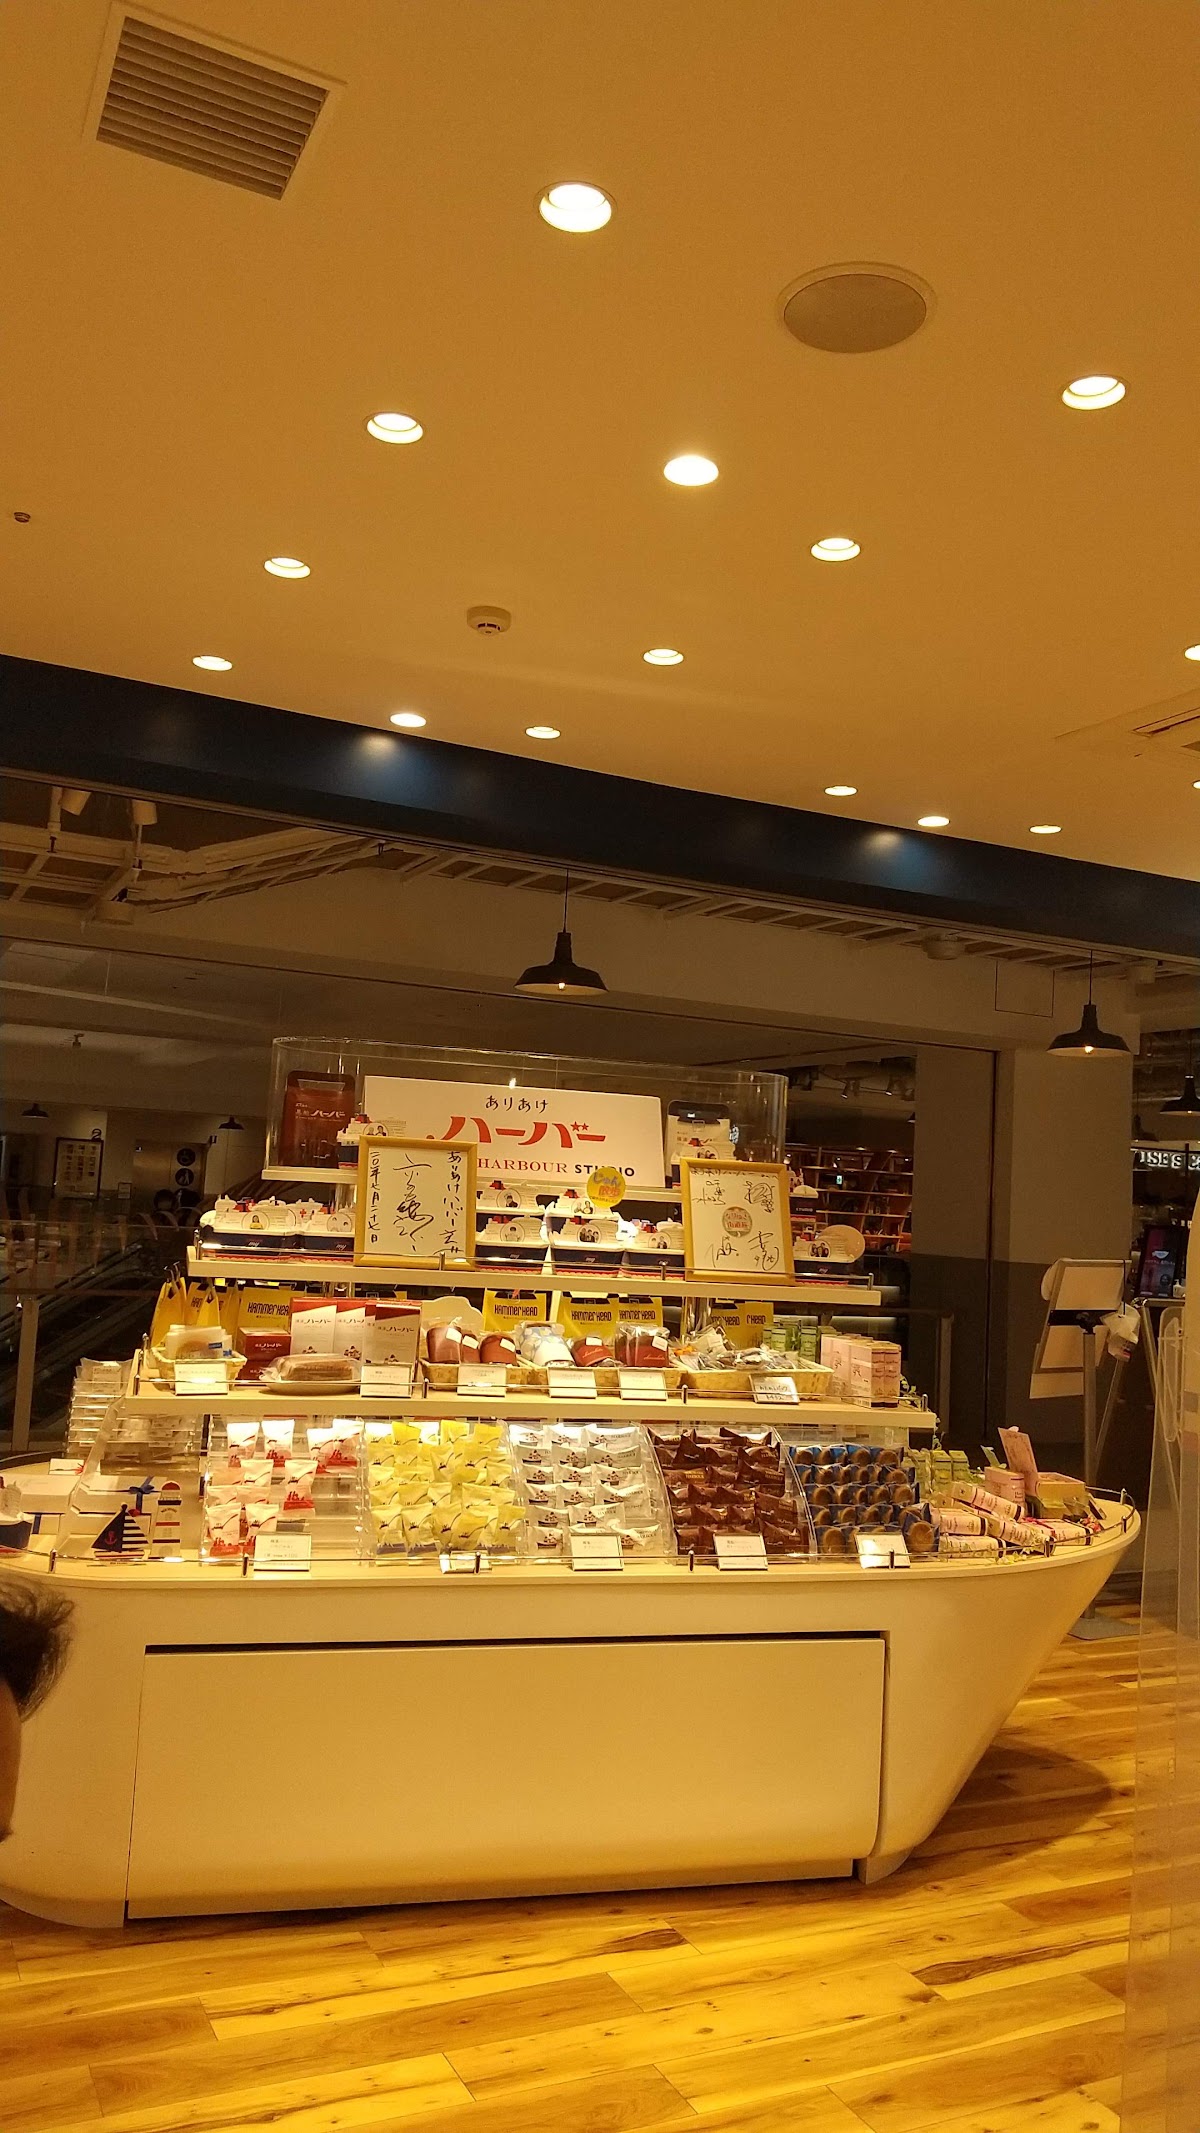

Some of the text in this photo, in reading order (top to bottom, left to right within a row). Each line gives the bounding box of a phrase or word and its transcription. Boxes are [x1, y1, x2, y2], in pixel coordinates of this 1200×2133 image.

[485, 1095, 549, 1114] ありあけ
[427, 1116, 606, 1149] ハーバー
[478, 1158, 635, 1177] HARBOUR STIO
[247, 1302, 289, 1316] HAMMERHEA
